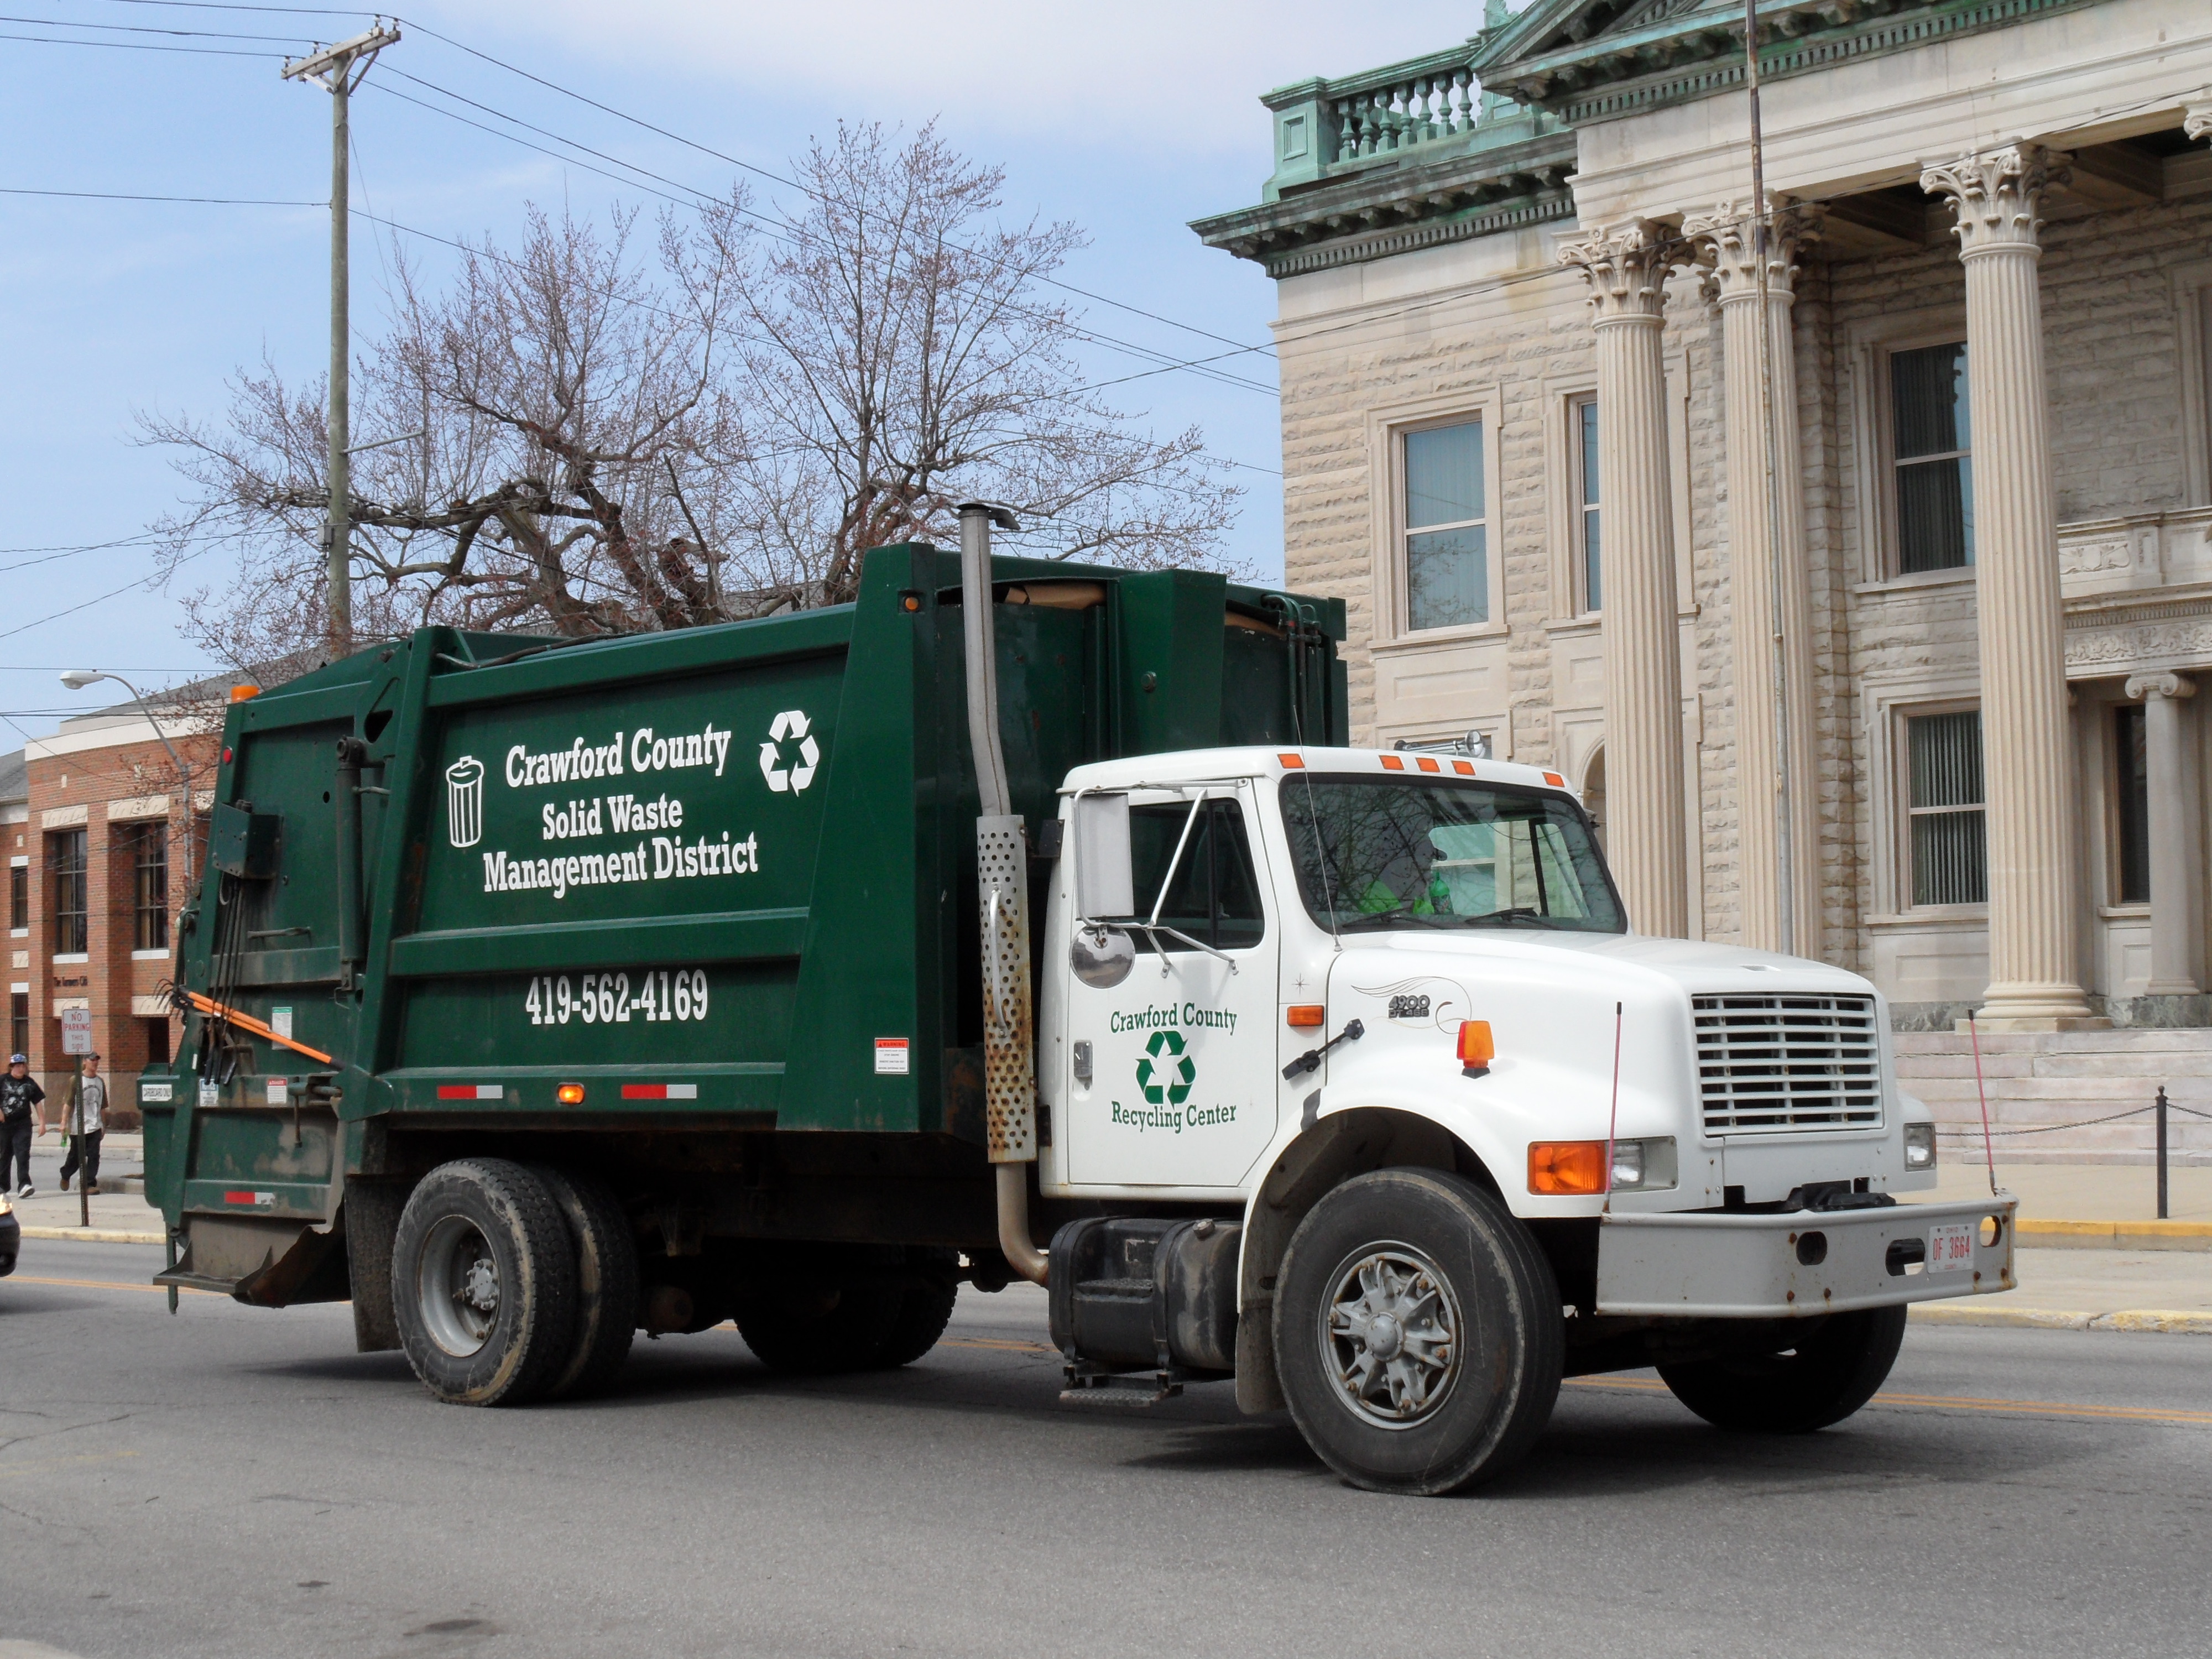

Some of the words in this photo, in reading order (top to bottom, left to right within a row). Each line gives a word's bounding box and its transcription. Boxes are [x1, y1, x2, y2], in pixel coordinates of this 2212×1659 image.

[505, 732, 624, 788] Crawford
[630, 722, 732, 777] County
[542, 798, 603, 840] Solid
[607, 792, 683, 833] Waste
[482, 841, 648, 899] Management
[651, 831, 758, 879] District
[525, 969, 708, 1025] 419-562-4169
[1389, 994, 1430, 1009] 4900
[1389, 1009, 1404, 1018] DT
[71, 1013, 82, 1021] NO
[1110, 1003, 1178, 1034] Crawford
[1183, 1001, 1238, 1036] County
[1111, 1100, 1182, 1134] Recycling
[1186, 1103, 1237, 1127] Center
[1949, 1235, 1970, 1259] 3664
